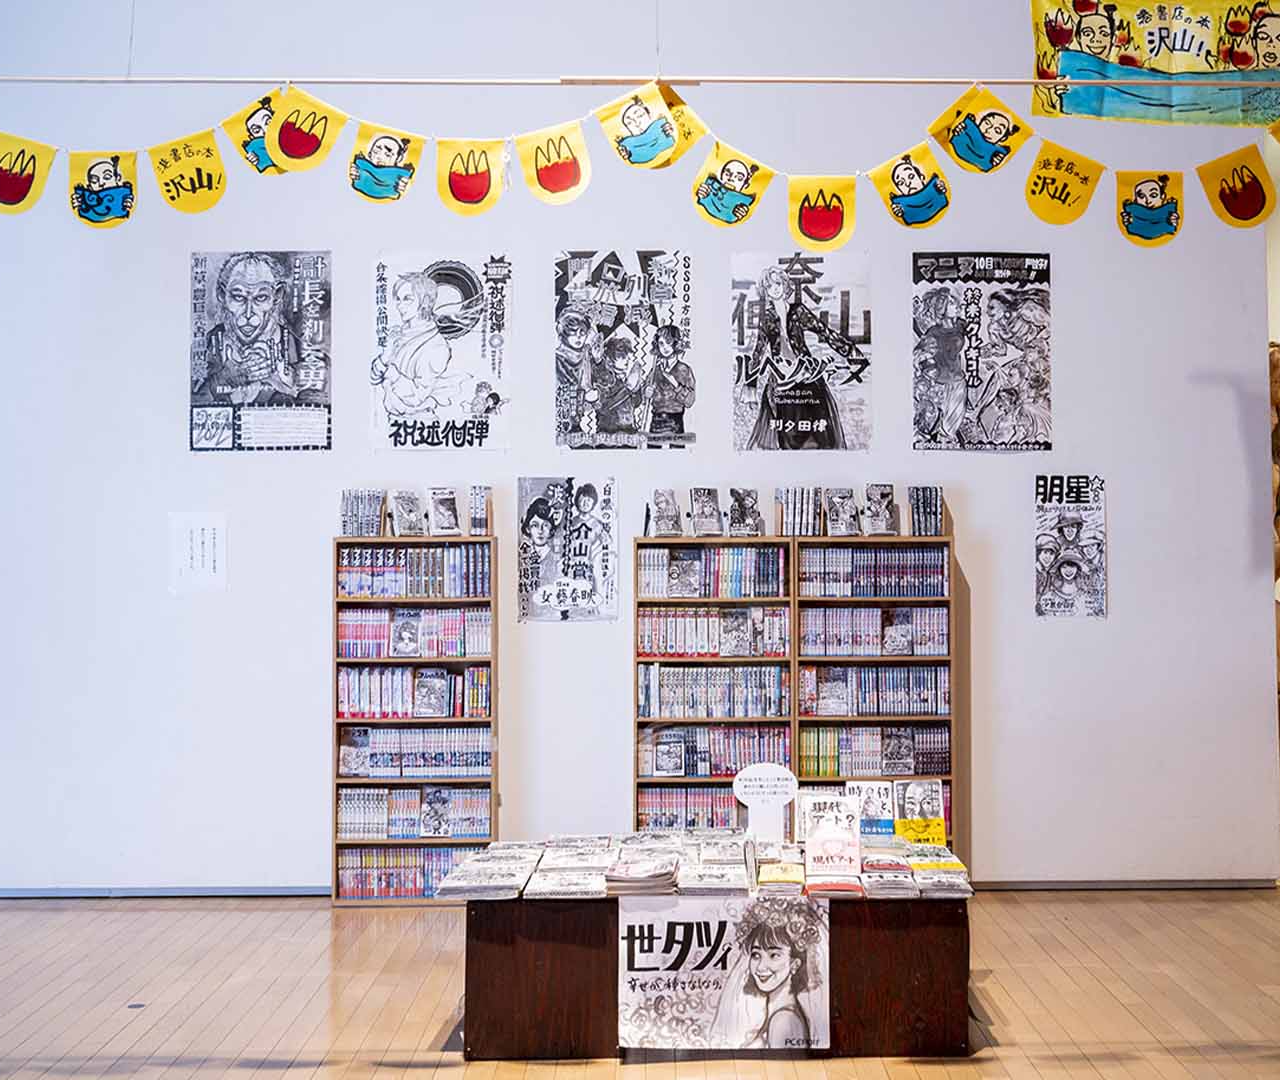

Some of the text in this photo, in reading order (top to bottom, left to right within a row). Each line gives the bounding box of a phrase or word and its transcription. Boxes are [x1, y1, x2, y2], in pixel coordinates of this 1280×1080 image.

[1147, 27, 1204, 57] 沢山!
[163, 167, 222, 201] 沢山!
[1031, 174, 1081, 207] 沢山!
